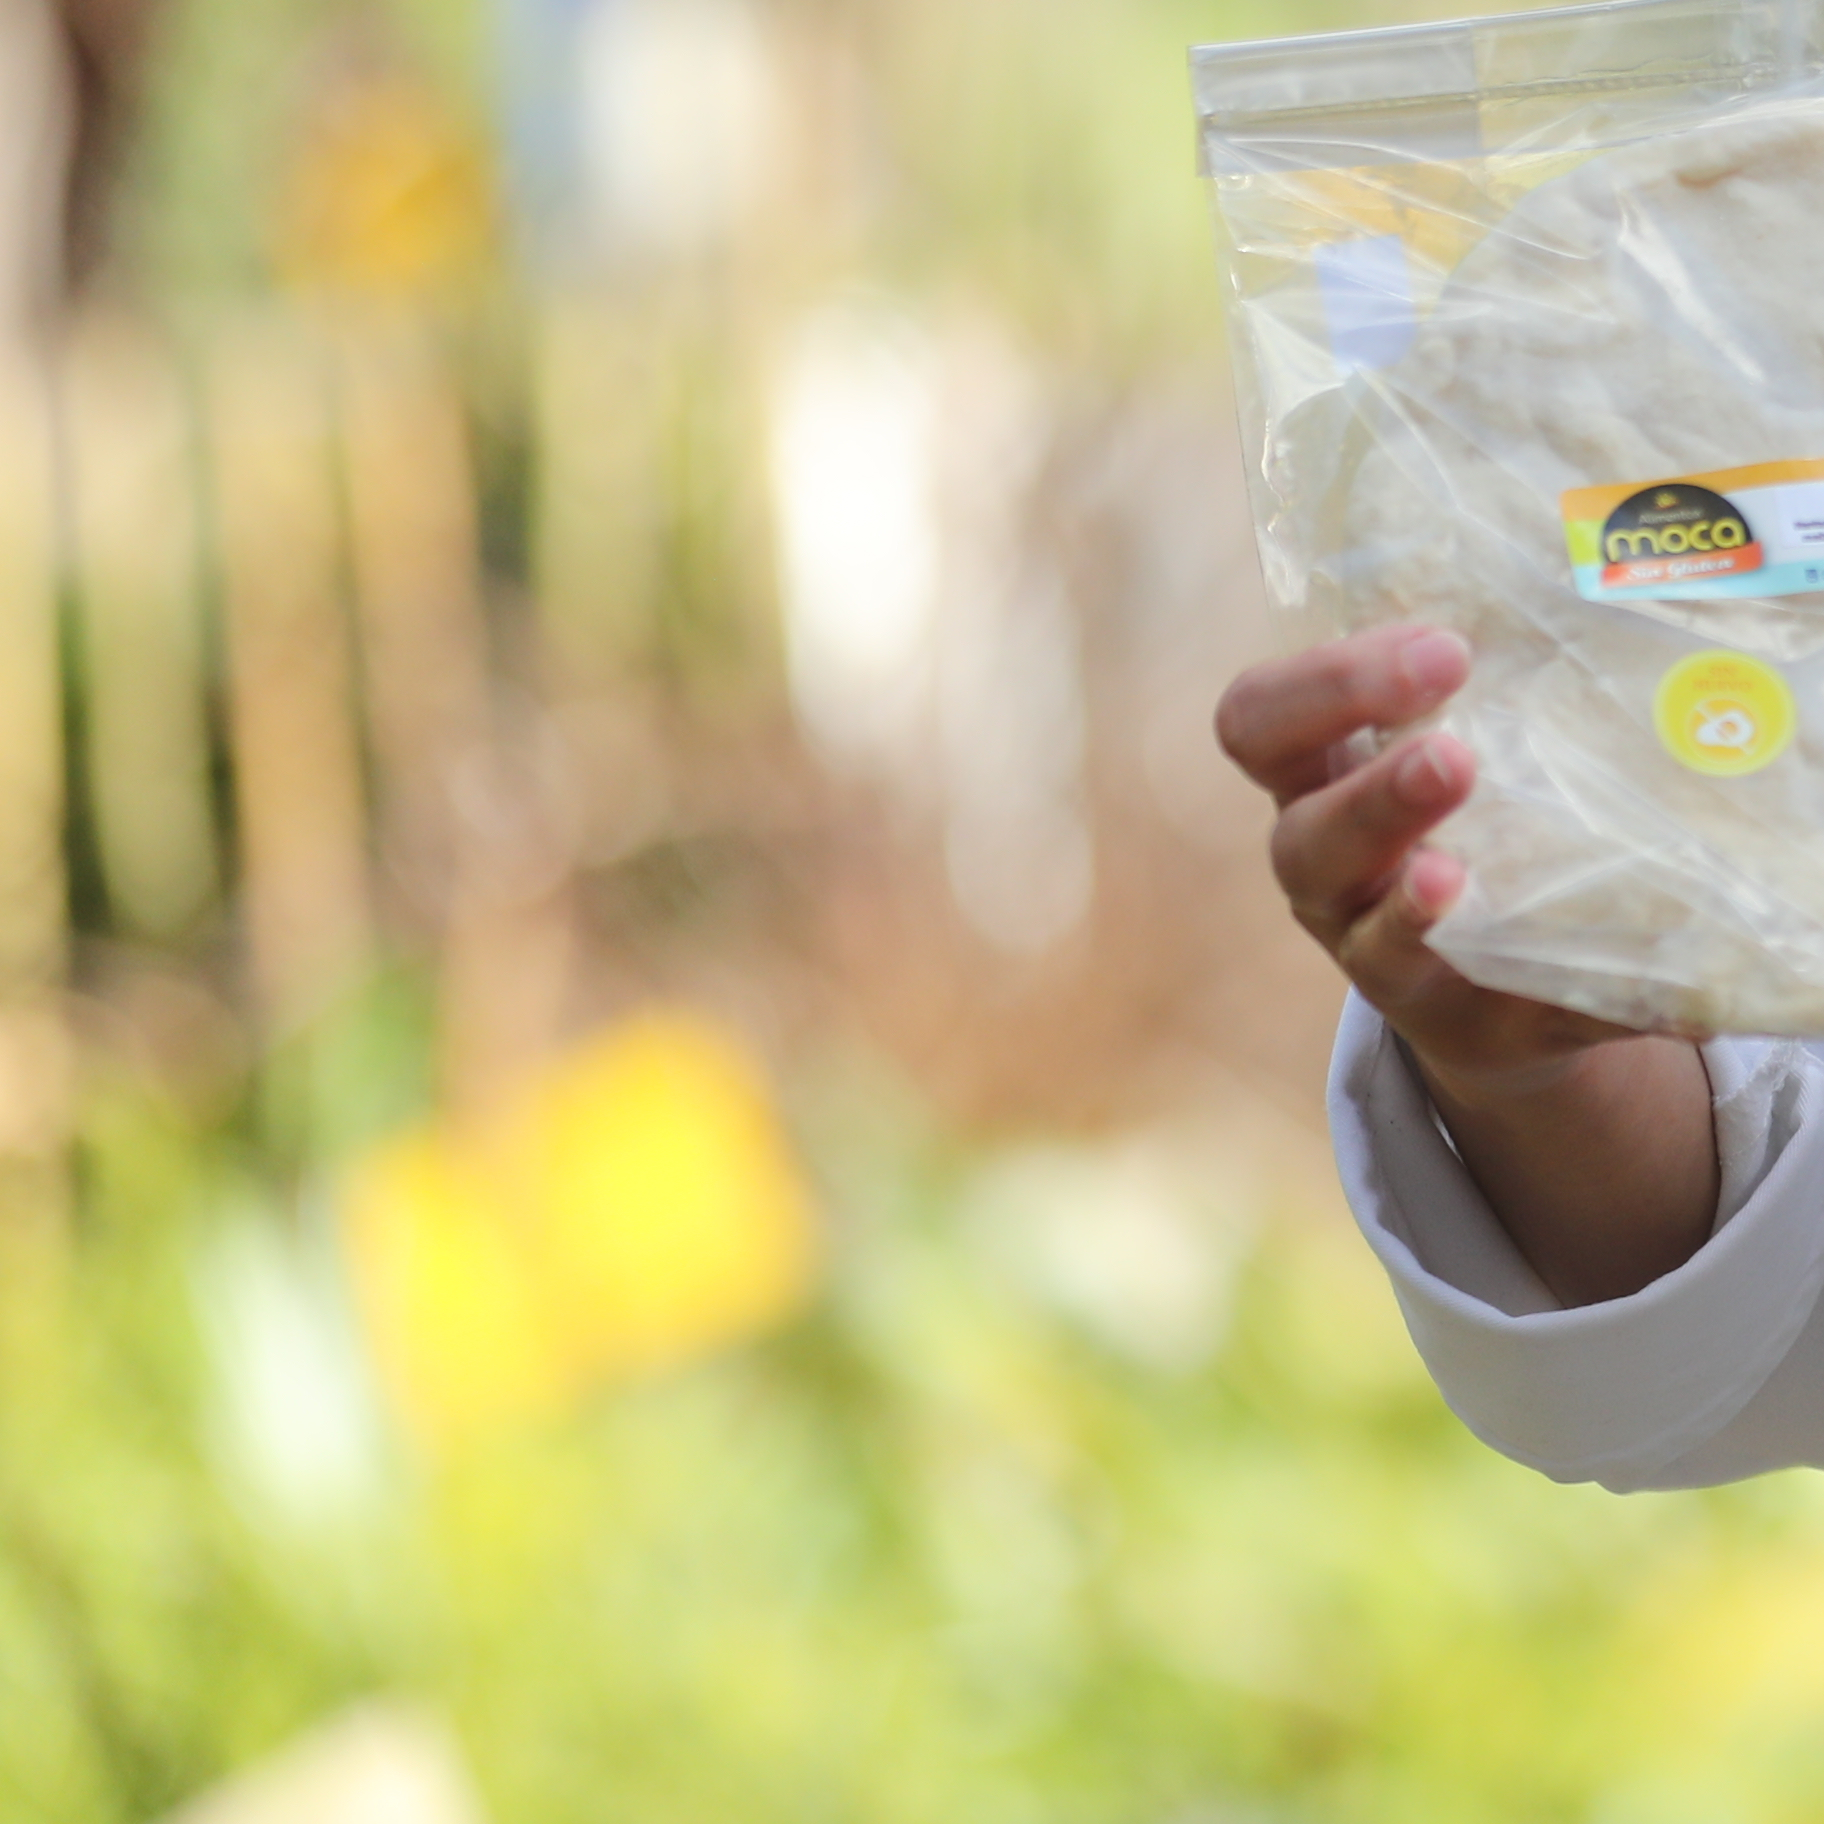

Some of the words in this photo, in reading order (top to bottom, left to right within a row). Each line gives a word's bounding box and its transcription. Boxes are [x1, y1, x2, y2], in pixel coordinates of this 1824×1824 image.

[1638, 507, 1702, 525] Alimentos
[1606, 518, 1746, 563] moca
[1627, 566, 1662, 581] Sin
[1667, 557, 1735, 580] Gluten
